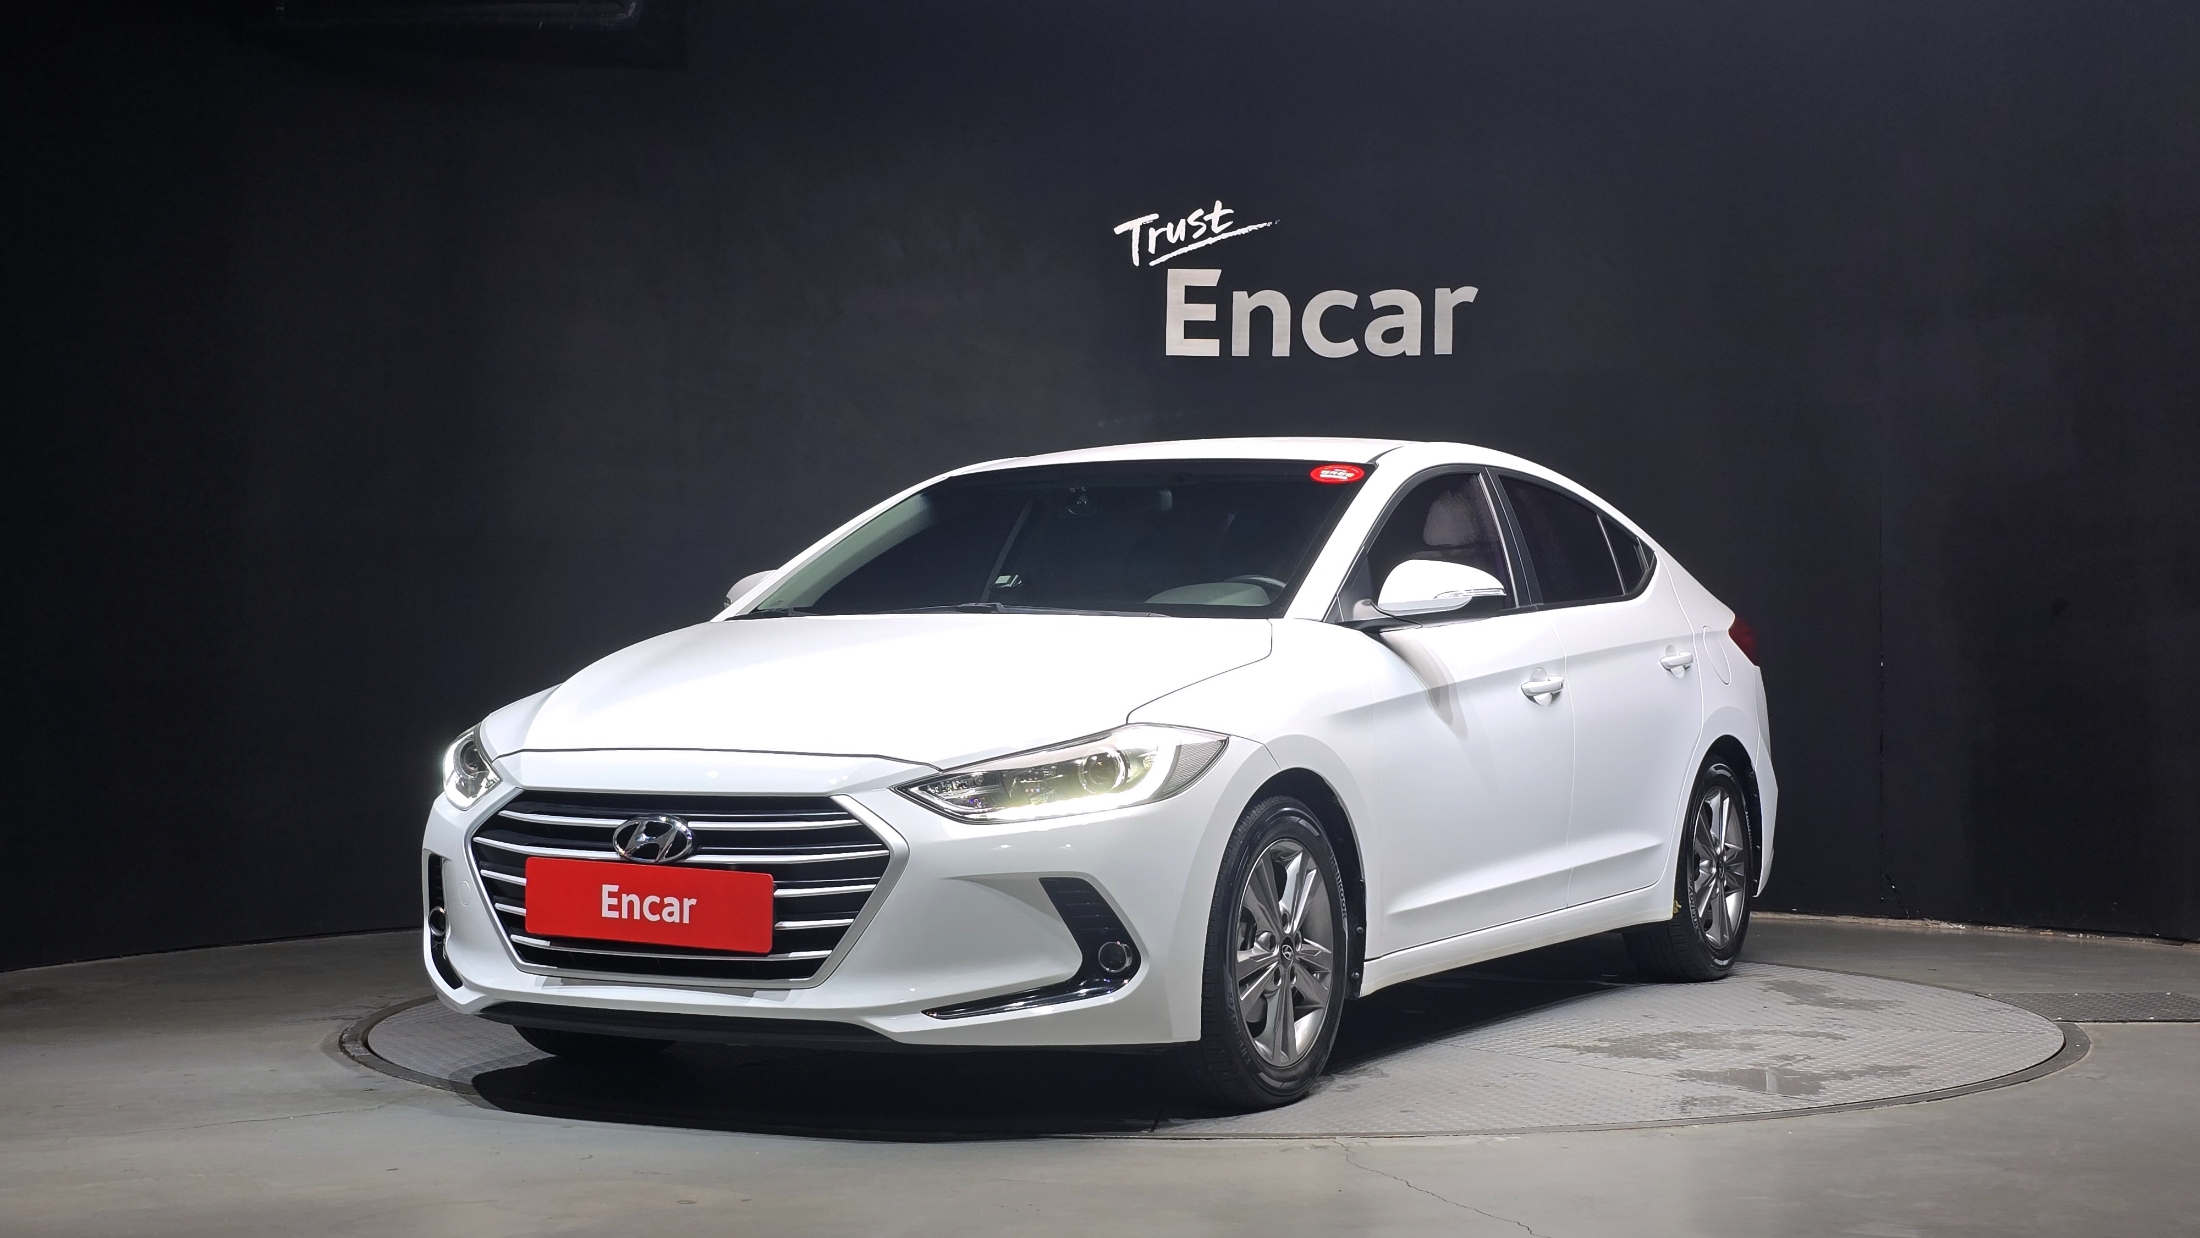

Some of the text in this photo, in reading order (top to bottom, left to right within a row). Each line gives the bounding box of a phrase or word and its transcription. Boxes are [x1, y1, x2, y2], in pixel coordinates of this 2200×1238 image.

[1113, 200, 1234, 267] Trust
[1165, 268, 1478, 359] Encar
[601, 884, 697, 924] Encar
